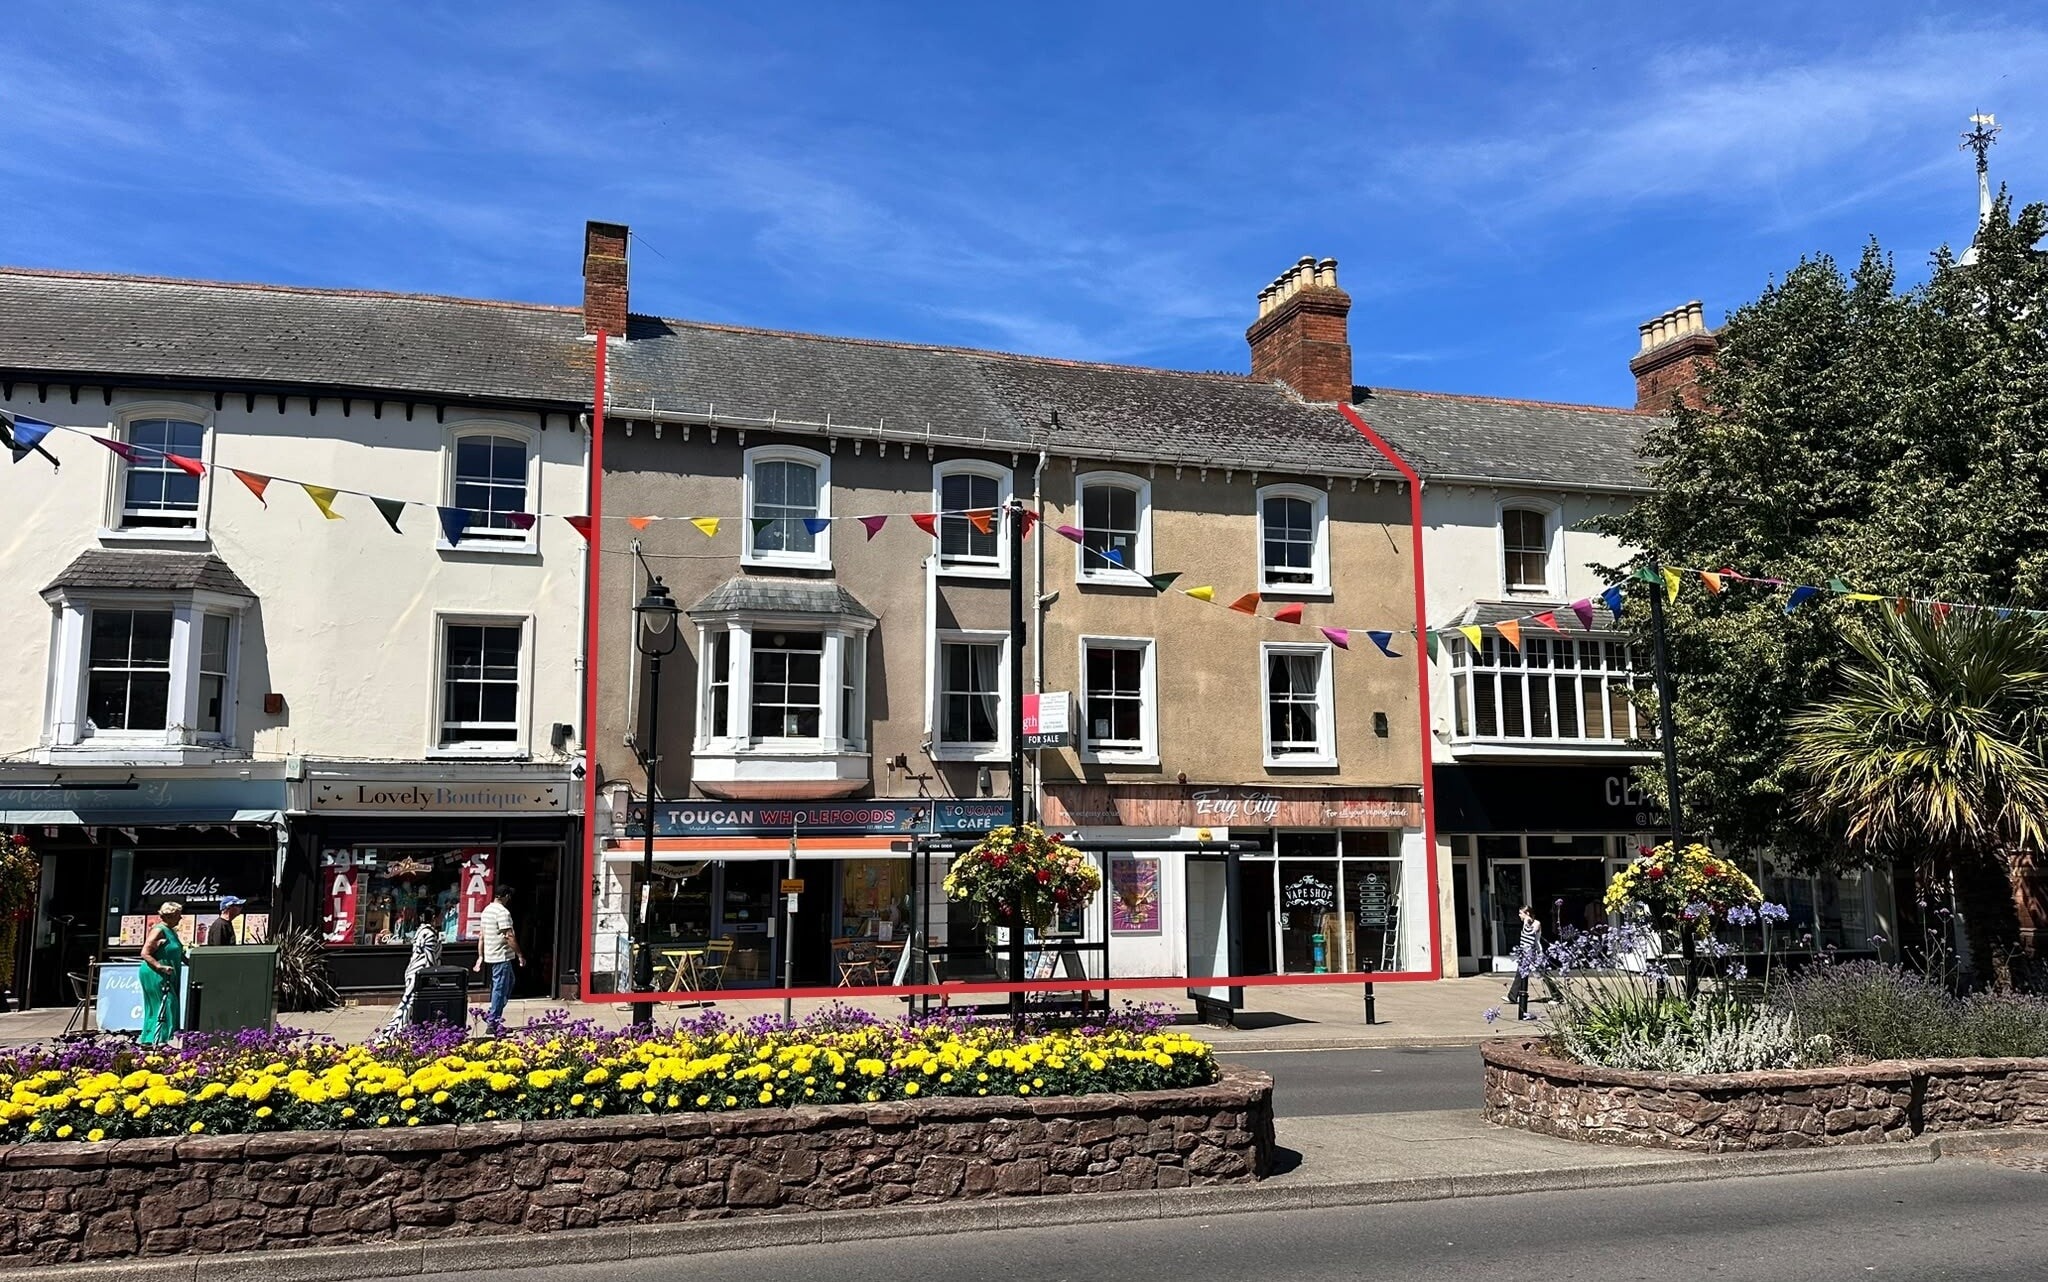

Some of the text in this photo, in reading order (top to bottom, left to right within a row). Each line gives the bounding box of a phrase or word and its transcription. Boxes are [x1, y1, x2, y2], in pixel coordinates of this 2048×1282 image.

[1028, 735, 1059, 743] FOR SALE
[356, 784, 527, 810] Lovely Boutique
[1192, 788, 1283, 822] E-cig City
[668, 809, 896, 825] TOUCAN WHOLEFOODS
[945, 806, 1004, 816] TOUCAN
[1325, 808, 1338, 818] For
[1349, 809, 1365, 819] your
[957, 815, 991, 829] CAFÉ
[320, 848, 377, 867] SALE
[141, 877, 220, 895] Wildish's
[1286, 888, 1333, 900] VAPE SHOP
[466, 853, 489, 940] SALE
